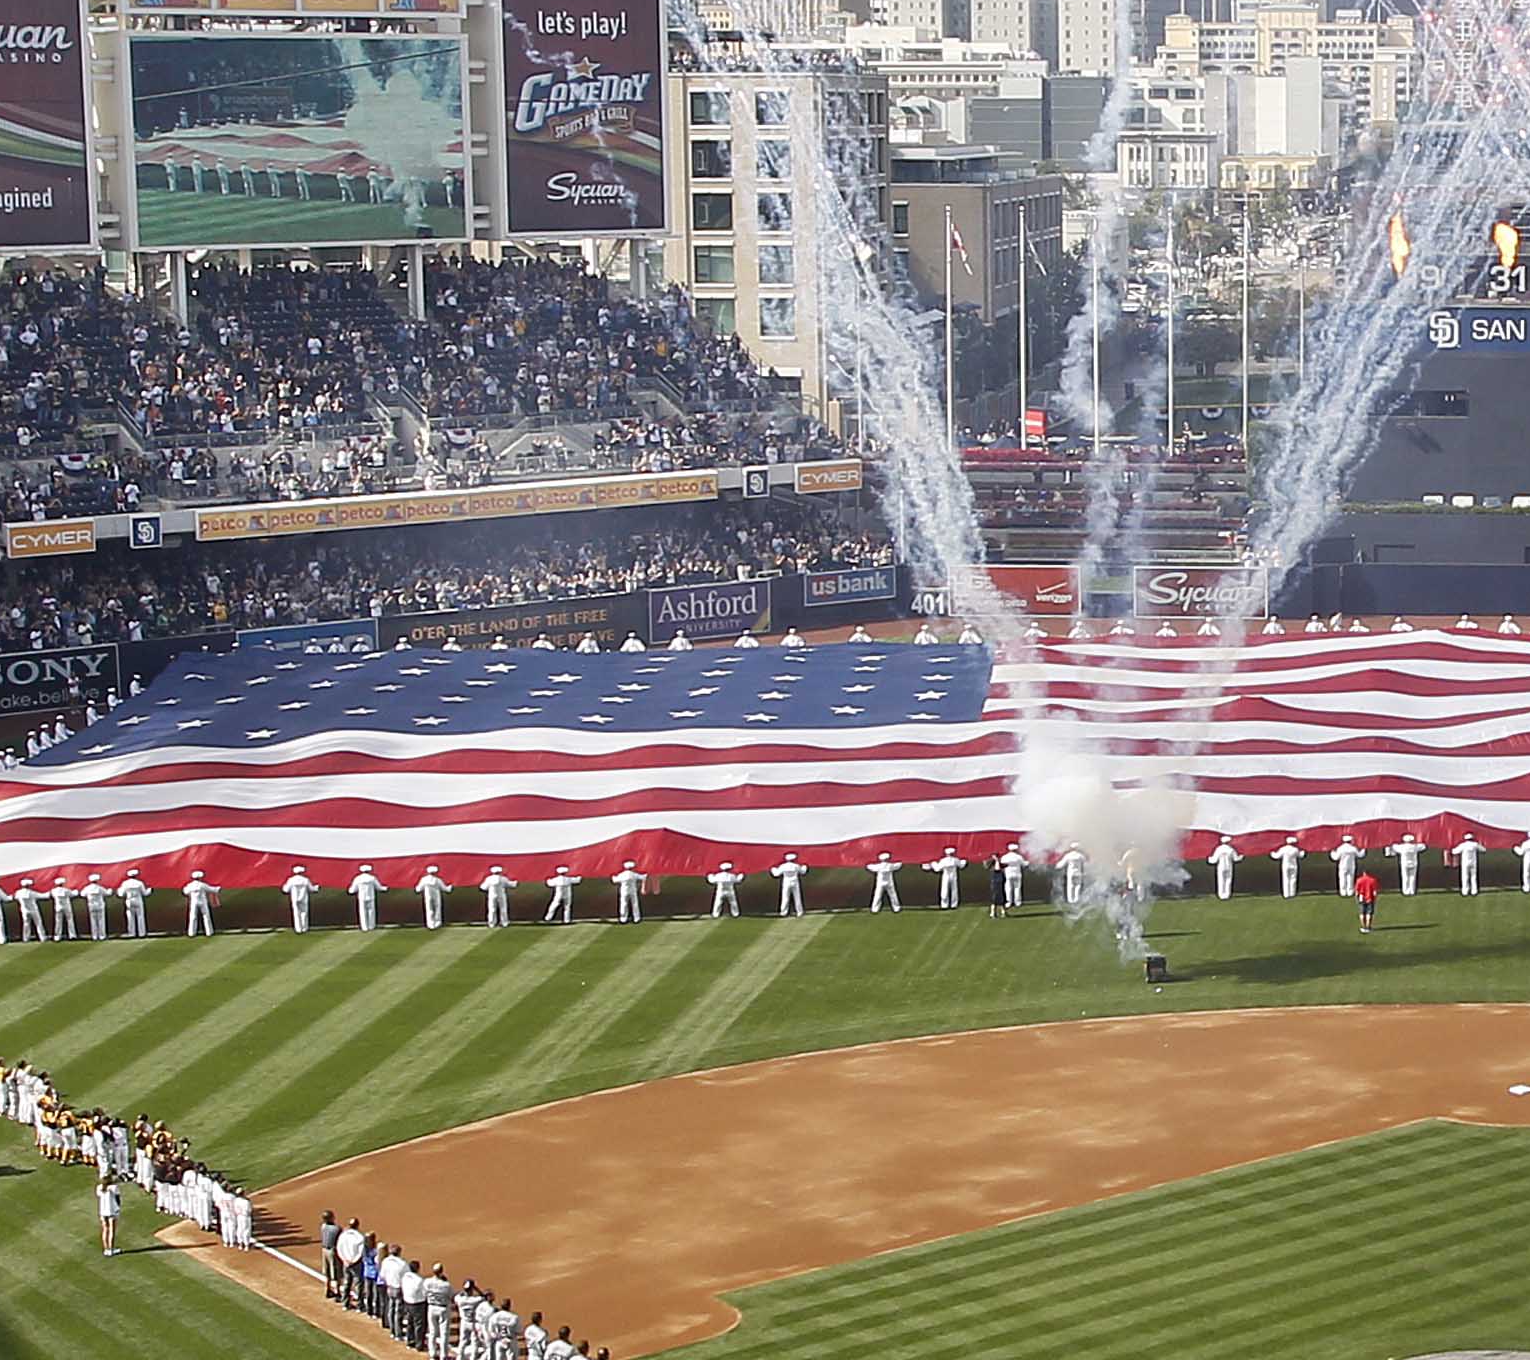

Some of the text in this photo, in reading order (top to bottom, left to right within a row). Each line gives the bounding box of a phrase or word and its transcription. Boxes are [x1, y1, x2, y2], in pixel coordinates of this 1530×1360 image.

[538, 11, 627, 40] let's play!
[546, 174, 626, 206] Sycuan
[1490, 265, 1526, 292] 31
[1472, 320, 1524, 340] SAN
[800, 469, 860, 488] CYMER
[660, 481, 699, 498] petco
[407, 501, 450, 518] petco
[472, 495, 514, 512] petco
[271, 511, 315, 529] petco
[340, 506, 383, 524] petco
[200, 518, 245, 536] petco
[12, 528, 94, 549] CYMER
[658, 587, 756, 623] Ashford
[911, 592, 946, 615] 401
[411, 609, 609, 641] O'ER THE LAND OF THE FREE
